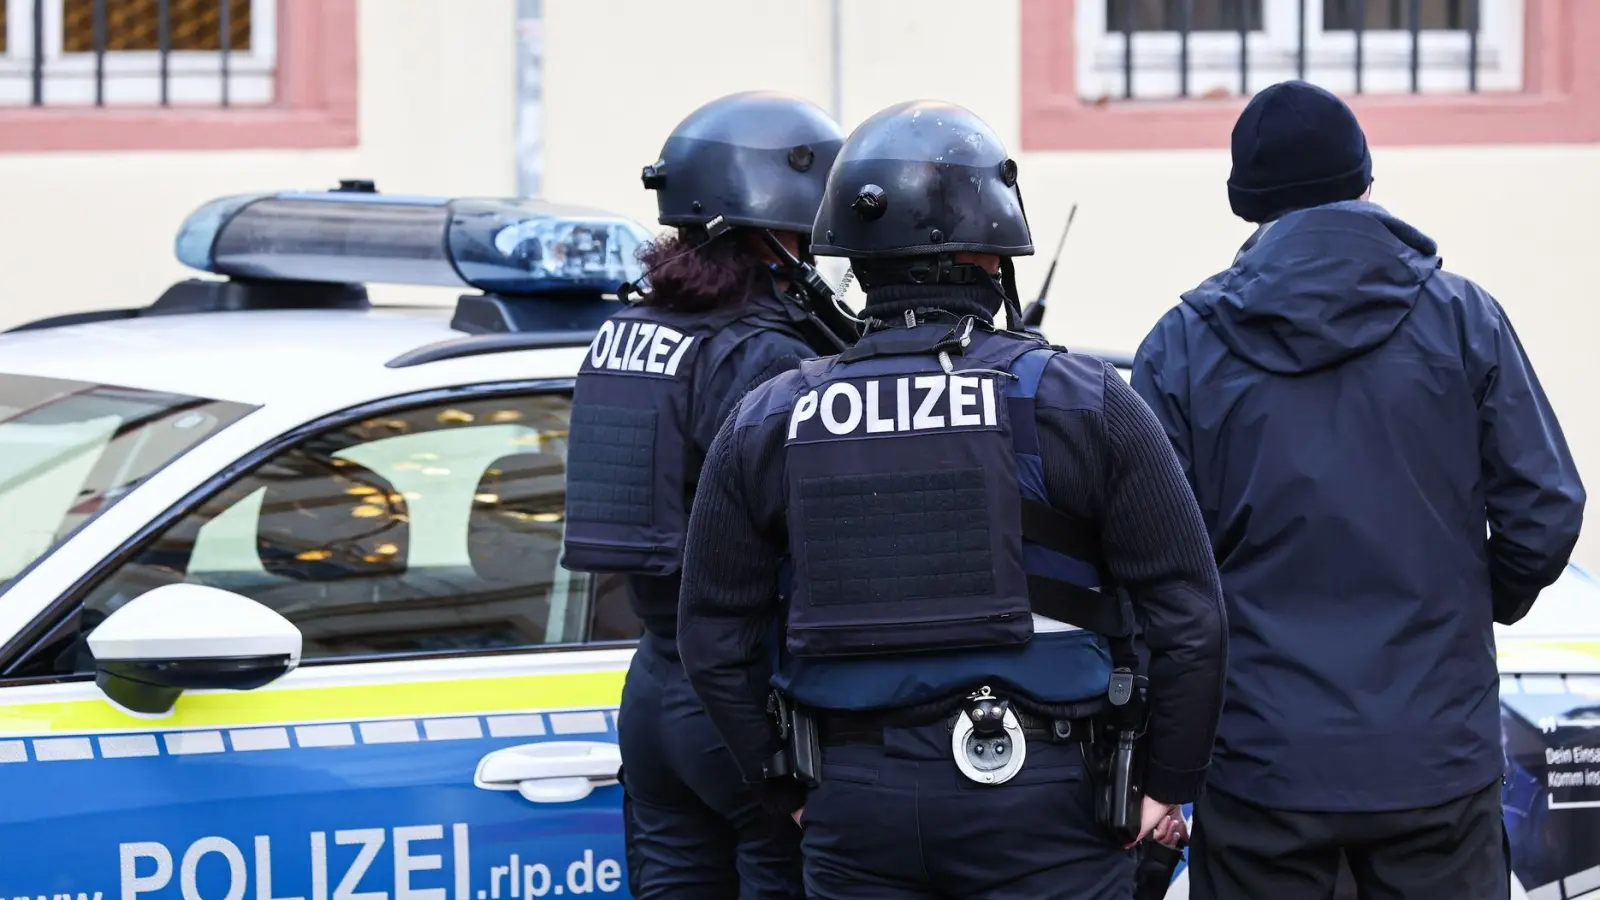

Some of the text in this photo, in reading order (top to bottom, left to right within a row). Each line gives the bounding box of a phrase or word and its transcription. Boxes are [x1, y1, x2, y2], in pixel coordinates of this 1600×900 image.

[590, 320, 695, 377] OLIZEI
[787, 375, 997, 440] POLIZEI
[1545, 746, 1572, 765] Dein
[1547, 770, 1584, 788] Komm
